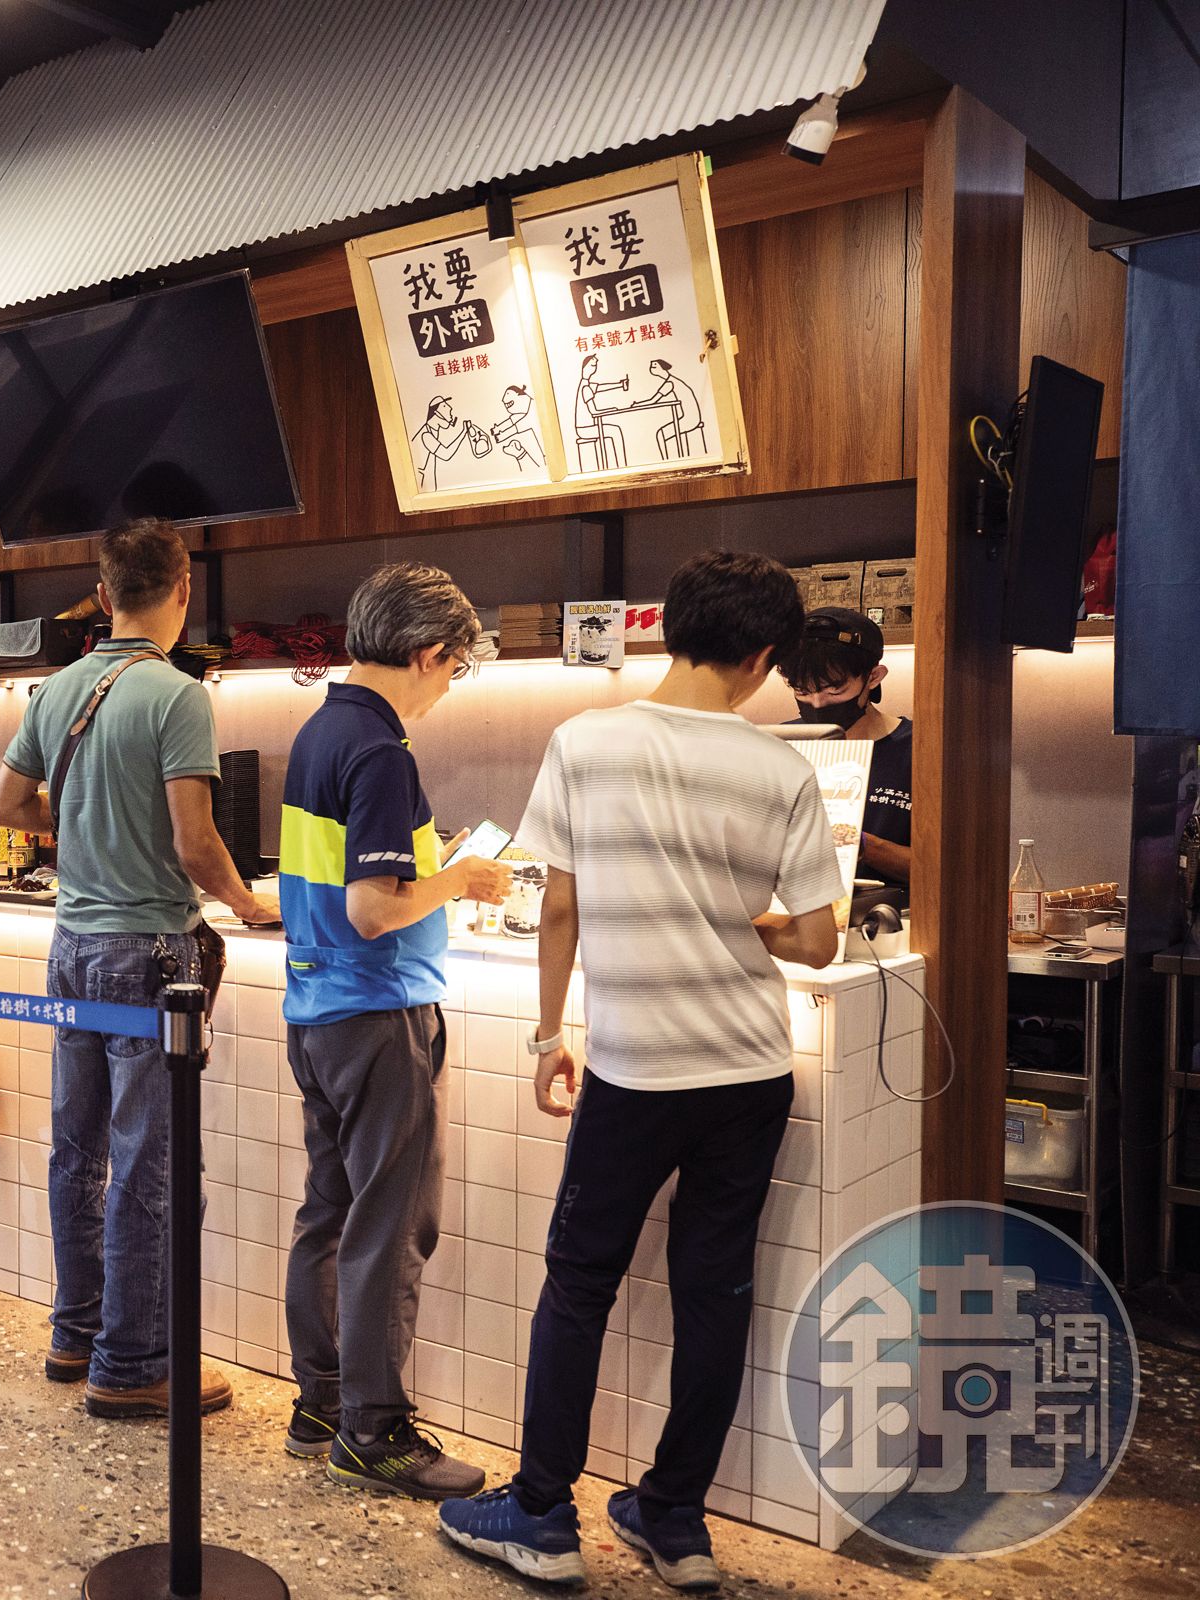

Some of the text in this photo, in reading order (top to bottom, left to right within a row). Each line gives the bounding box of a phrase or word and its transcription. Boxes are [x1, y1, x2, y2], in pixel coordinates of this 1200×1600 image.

[564, 209, 644, 275] 我要
[403, 247, 477, 310] 我要
[582, 275, 651, 319] 內用
[418, 306, 482, 350] 外帶
[575, 321, 673, 352] 有桌號才點餐
[433, 354, 491, 377] 直接排隊
[0, 997, 76, 1025] 榕樹下米苔目
